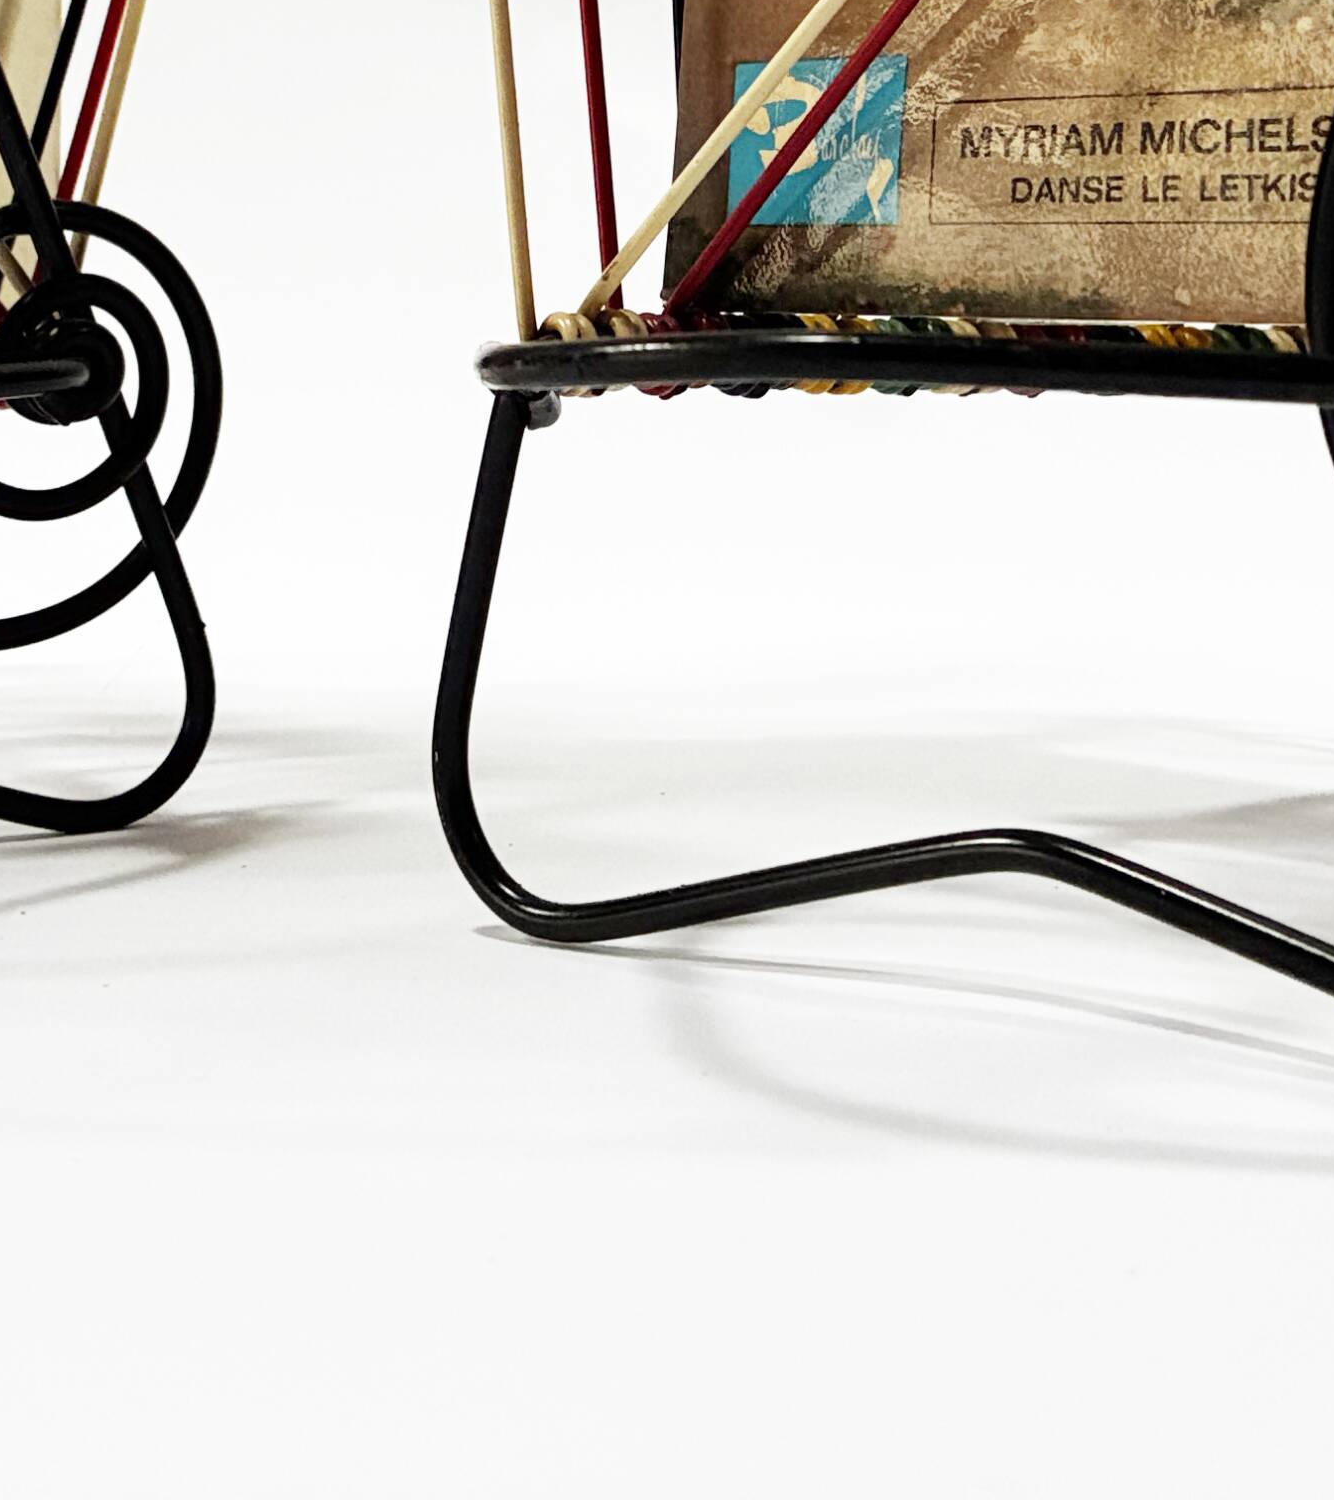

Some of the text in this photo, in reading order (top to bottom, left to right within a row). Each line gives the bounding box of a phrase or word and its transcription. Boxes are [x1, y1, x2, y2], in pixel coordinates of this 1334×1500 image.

[960, 121, 1124, 158] MYRIAM
[1011, 176, 1124, 204] DANSE
[1142, 175, 1181, 203] LE
